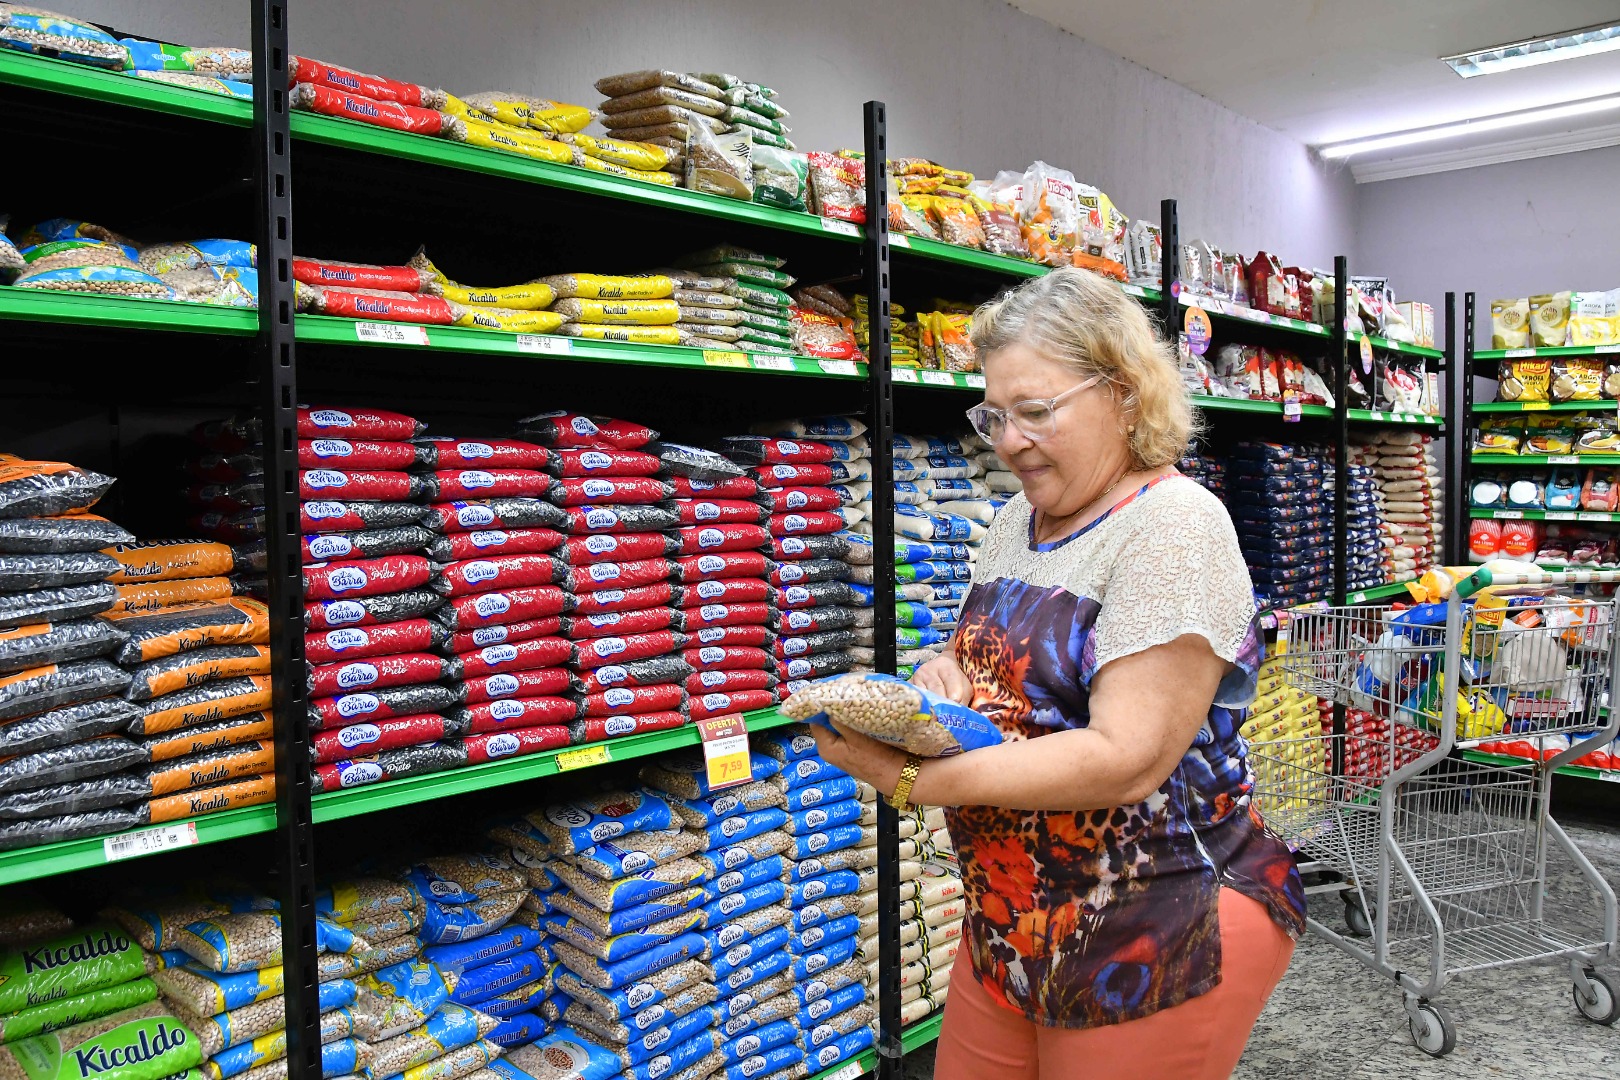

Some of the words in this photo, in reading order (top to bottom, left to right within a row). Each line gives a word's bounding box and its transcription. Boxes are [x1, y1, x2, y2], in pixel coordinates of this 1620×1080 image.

[328, 70, 360, 89] Kicaldo
[344, 97, 378, 117] Kicaldo
[321, 267, 356, 280] Kicaldo
[598, 287, 623, 297] Kicaldo
[469, 293, 497, 303] Kicaldo
[355, 299, 392, 314] Kicaldo
[473, 315, 501, 329] Kicaldo
[314, 413, 348, 423] Barra
[315, 442, 349, 452] Barra
[356, 443, 381, 451] Preto
[309, 473, 343, 483] Barra
[307, 503, 343, 514] Barra
[461, 512, 491, 523] Barra
[589, 516, 614, 525] Barra
[355, 537, 380, 546] Preto
[701, 535, 722, 543] Barra
[314, 542, 348, 553] Barra
[588, 541, 614, 550] Barra
[125, 563, 162, 576] Kicaldo
[371, 570, 395, 580] Preto
[466, 566, 495, 579] Barra
[593, 567, 617, 577] Barra
[332, 575, 364, 586] Barra
[514, 595, 533, 604] Preto
[369, 603, 392, 613] Preto
[479, 602, 506, 612] Barra
[329, 610, 361, 620] Barra
[511, 624, 531, 633] Preto
[330, 633, 361, 644] Barra
[476, 630, 504, 641] Barra
[186, 667, 222, 685] Kicaldo
[382, 666, 407, 675] Preto
[341, 672, 373, 684] Barra
[523, 677, 542, 685] Preto
[488, 681, 516, 693] Barra
[637, 689, 654, 697] Preto
[341, 700, 375, 712] Barra
[493, 704, 521, 715] Barra
[183, 708, 222, 725] Kicaldo
[608, 721, 633, 731] Barra
[706, 718, 737, 730] OFERTA
[342, 729, 376, 742] Barra
[523, 735, 543, 743] Preto
[192, 737, 230, 752] Kicaldo
[489, 741, 517, 753] Barra
[386, 763, 411, 773] Preto
[720, 760, 742, 778] 7,59
[190, 768, 229, 785] Kicaldo
[345, 771, 377, 784] Barra
[190, 795, 229, 813] Kicaldo
[594, 827, 621, 838] Barra
[625, 859, 647, 871] Barra
[726, 856, 745, 866] Barra
[720, 878, 741, 889] Barra
[432, 884, 458, 895] Barra
[722, 900, 743, 910] Barra
[721, 932, 741, 943] Barra
[23, 933, 129, 974] Kicaldo
[476, 941, 515, 959] LIGEIRINHO
[729, 951, 749, 961] Barra
[485, 971, 525, 991] LIGEIRINHO
[730, 974, 751, 984] Barra
[27, 986, 68, 1006] Kicaldo
[630, 992, 653, 1005] Barra
[639, 1012, 662, 1025] Barra
[646, 1034, 668, 1047] Barra
[75, 1024, 186, 1077] Kicaldo
